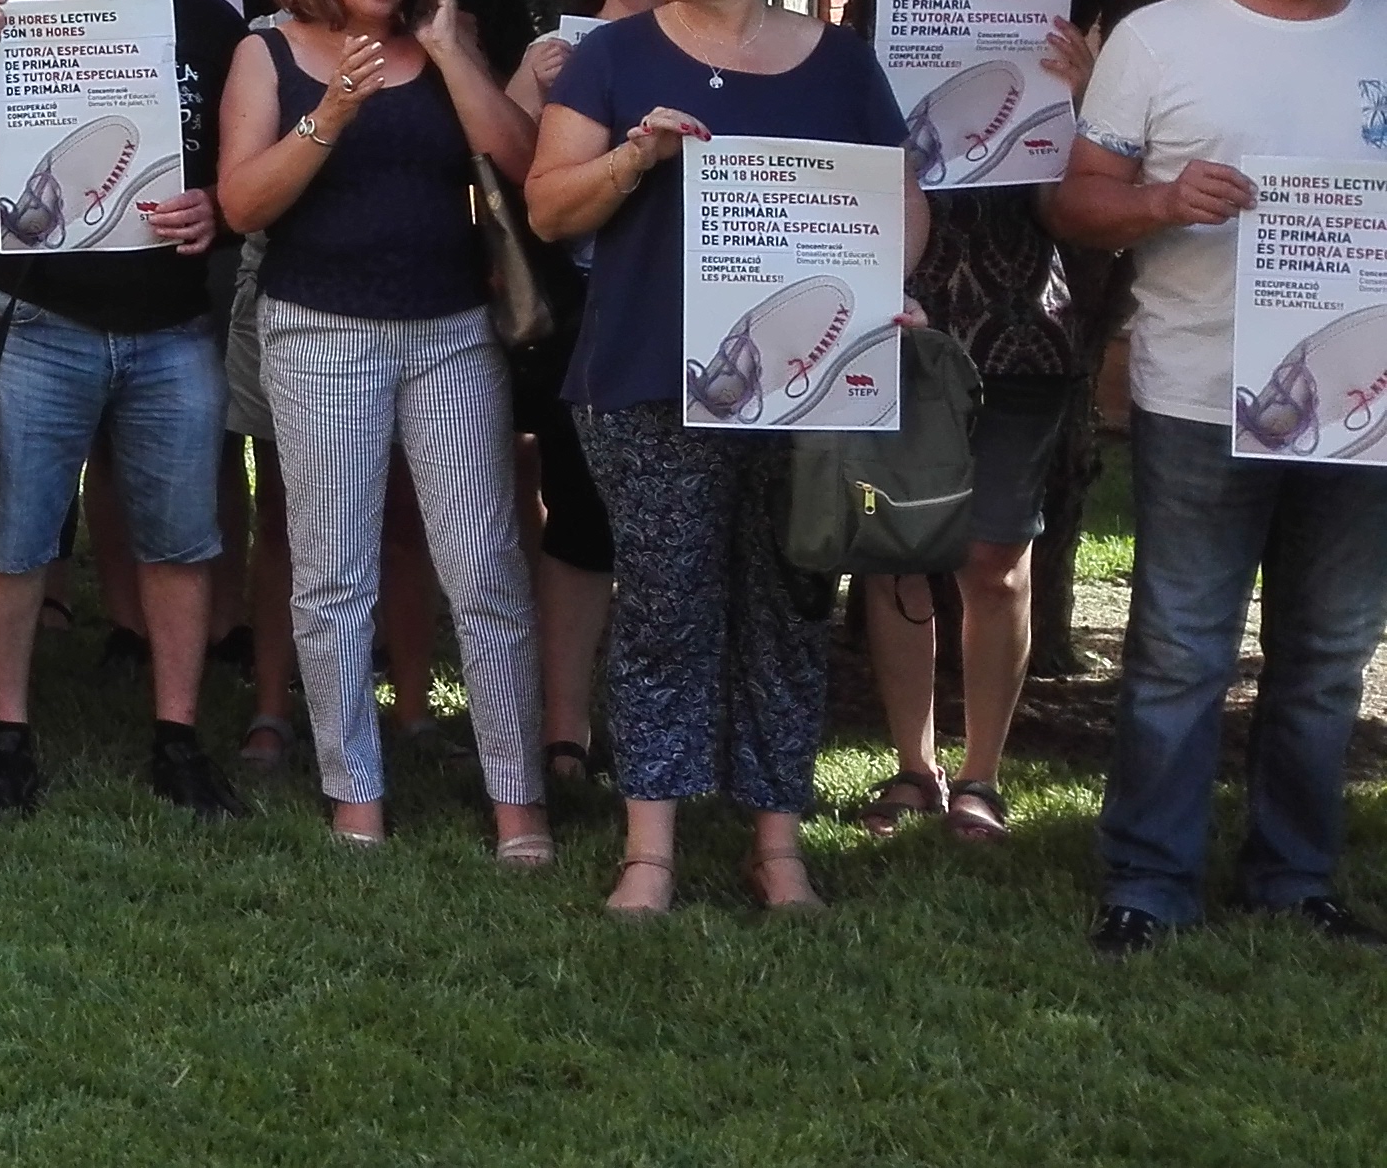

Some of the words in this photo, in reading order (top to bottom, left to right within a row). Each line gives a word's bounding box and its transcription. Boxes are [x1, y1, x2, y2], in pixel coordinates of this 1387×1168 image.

[893, 0, 908, 9] DE
[19, 15, 57, 25] HORES
[61, 12, 116, 23] LECTIVES
[911, 12, 963, 23] TUTOR/A
[967, 13, 1048, 23] ESPECIALISTA
[31, 28, 43, 37] 18
[46, 27, 85, 36] HORES
[892, 26, 907, 35] DE
[5, 47, 54, 58] TUTOR/A
[58, 44, 138, 55] ESPECIALISTA
[5, 61, 19, 71] DE
[703, 155, 716, 165] 18
[720, 156, 765, 166] HORES
[769, 157, 834, 170] LECTIVES
[734, 171, 747, 180] 18
[751, 171, 796, 181] HORES
[1262, 176, 1277, 186] 18
[1281, 177, 1330, 188] HORES
[702, 192, 759, 203] TUTOR/A
[763, 194, 858, 206] ESPECIALISTA
[1296, 193, 1310, 203] 18
[1314, 194, 1363, 205] HORES
[702, 207, 719, 217] DE
[723, 221, 781, 233] TUTOR/A
[784, 222, 879, 235] ESPECIALISTA
[702, 235, 719, 245] DE
[702, 265, 747, 273] COMPLETA
[848, 387, 878, 397] STEPV
